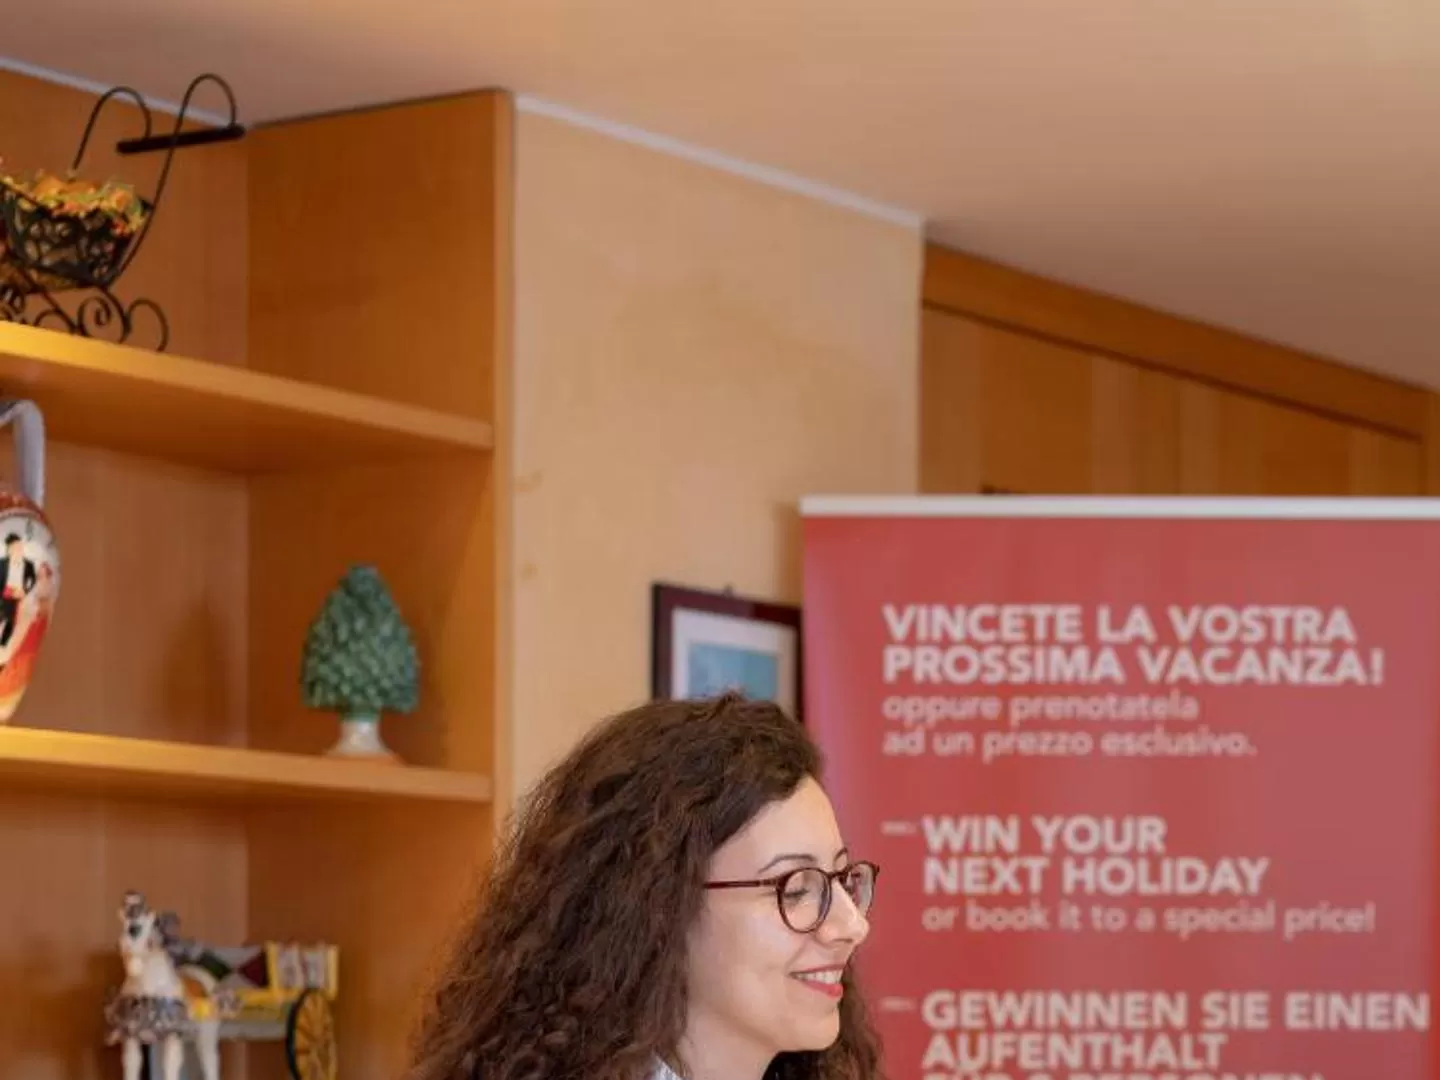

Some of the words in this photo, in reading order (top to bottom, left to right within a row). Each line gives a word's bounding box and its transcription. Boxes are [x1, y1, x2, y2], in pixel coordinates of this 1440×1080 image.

[882, 604, 1082, 643] VINCETE
[1098, 605, 1156, 643] LA
[1168, 606, 1357, 645] VOSTRA
[883, 645, 1125, 684] PROSSIMA
[1138, 647, 1385, 686] VACANZA!
[881, 695, 1001, 729] oppure
[1010, 689, 1199, 730] prenotatela
[883, 727, 924, 755] ad
[933, 732, 974, 755] un
[983, 732, 1093, 763] prezzo
[1100, 727, 1258, 757] esclusivo.
[921, 815, 1019, 853] WIN
[1032, 816, 1167, 853] YOUR
[924, 856, 1049, 894] NEXT
[1063, 857, 1270, 895] HOLIDAY
[922, 905, 958, 931] or
[966, 899, 1050, 931] book
[1059, 900, 1082, 931] it
[1091, 902, 1127, 932] to
[1135, 907, 1156, 932] a
[1164, 901, 1276, 939] special
[1283, 902, 1376, 940] price!
[922, 990, 1187, 1030] GEWINNEN
[1201, 990, 1269, 1029] SIE
[1285, 991, 1431, 1030] EINEN
[921, 1032, 1228, 1070] AUFENTHALT
